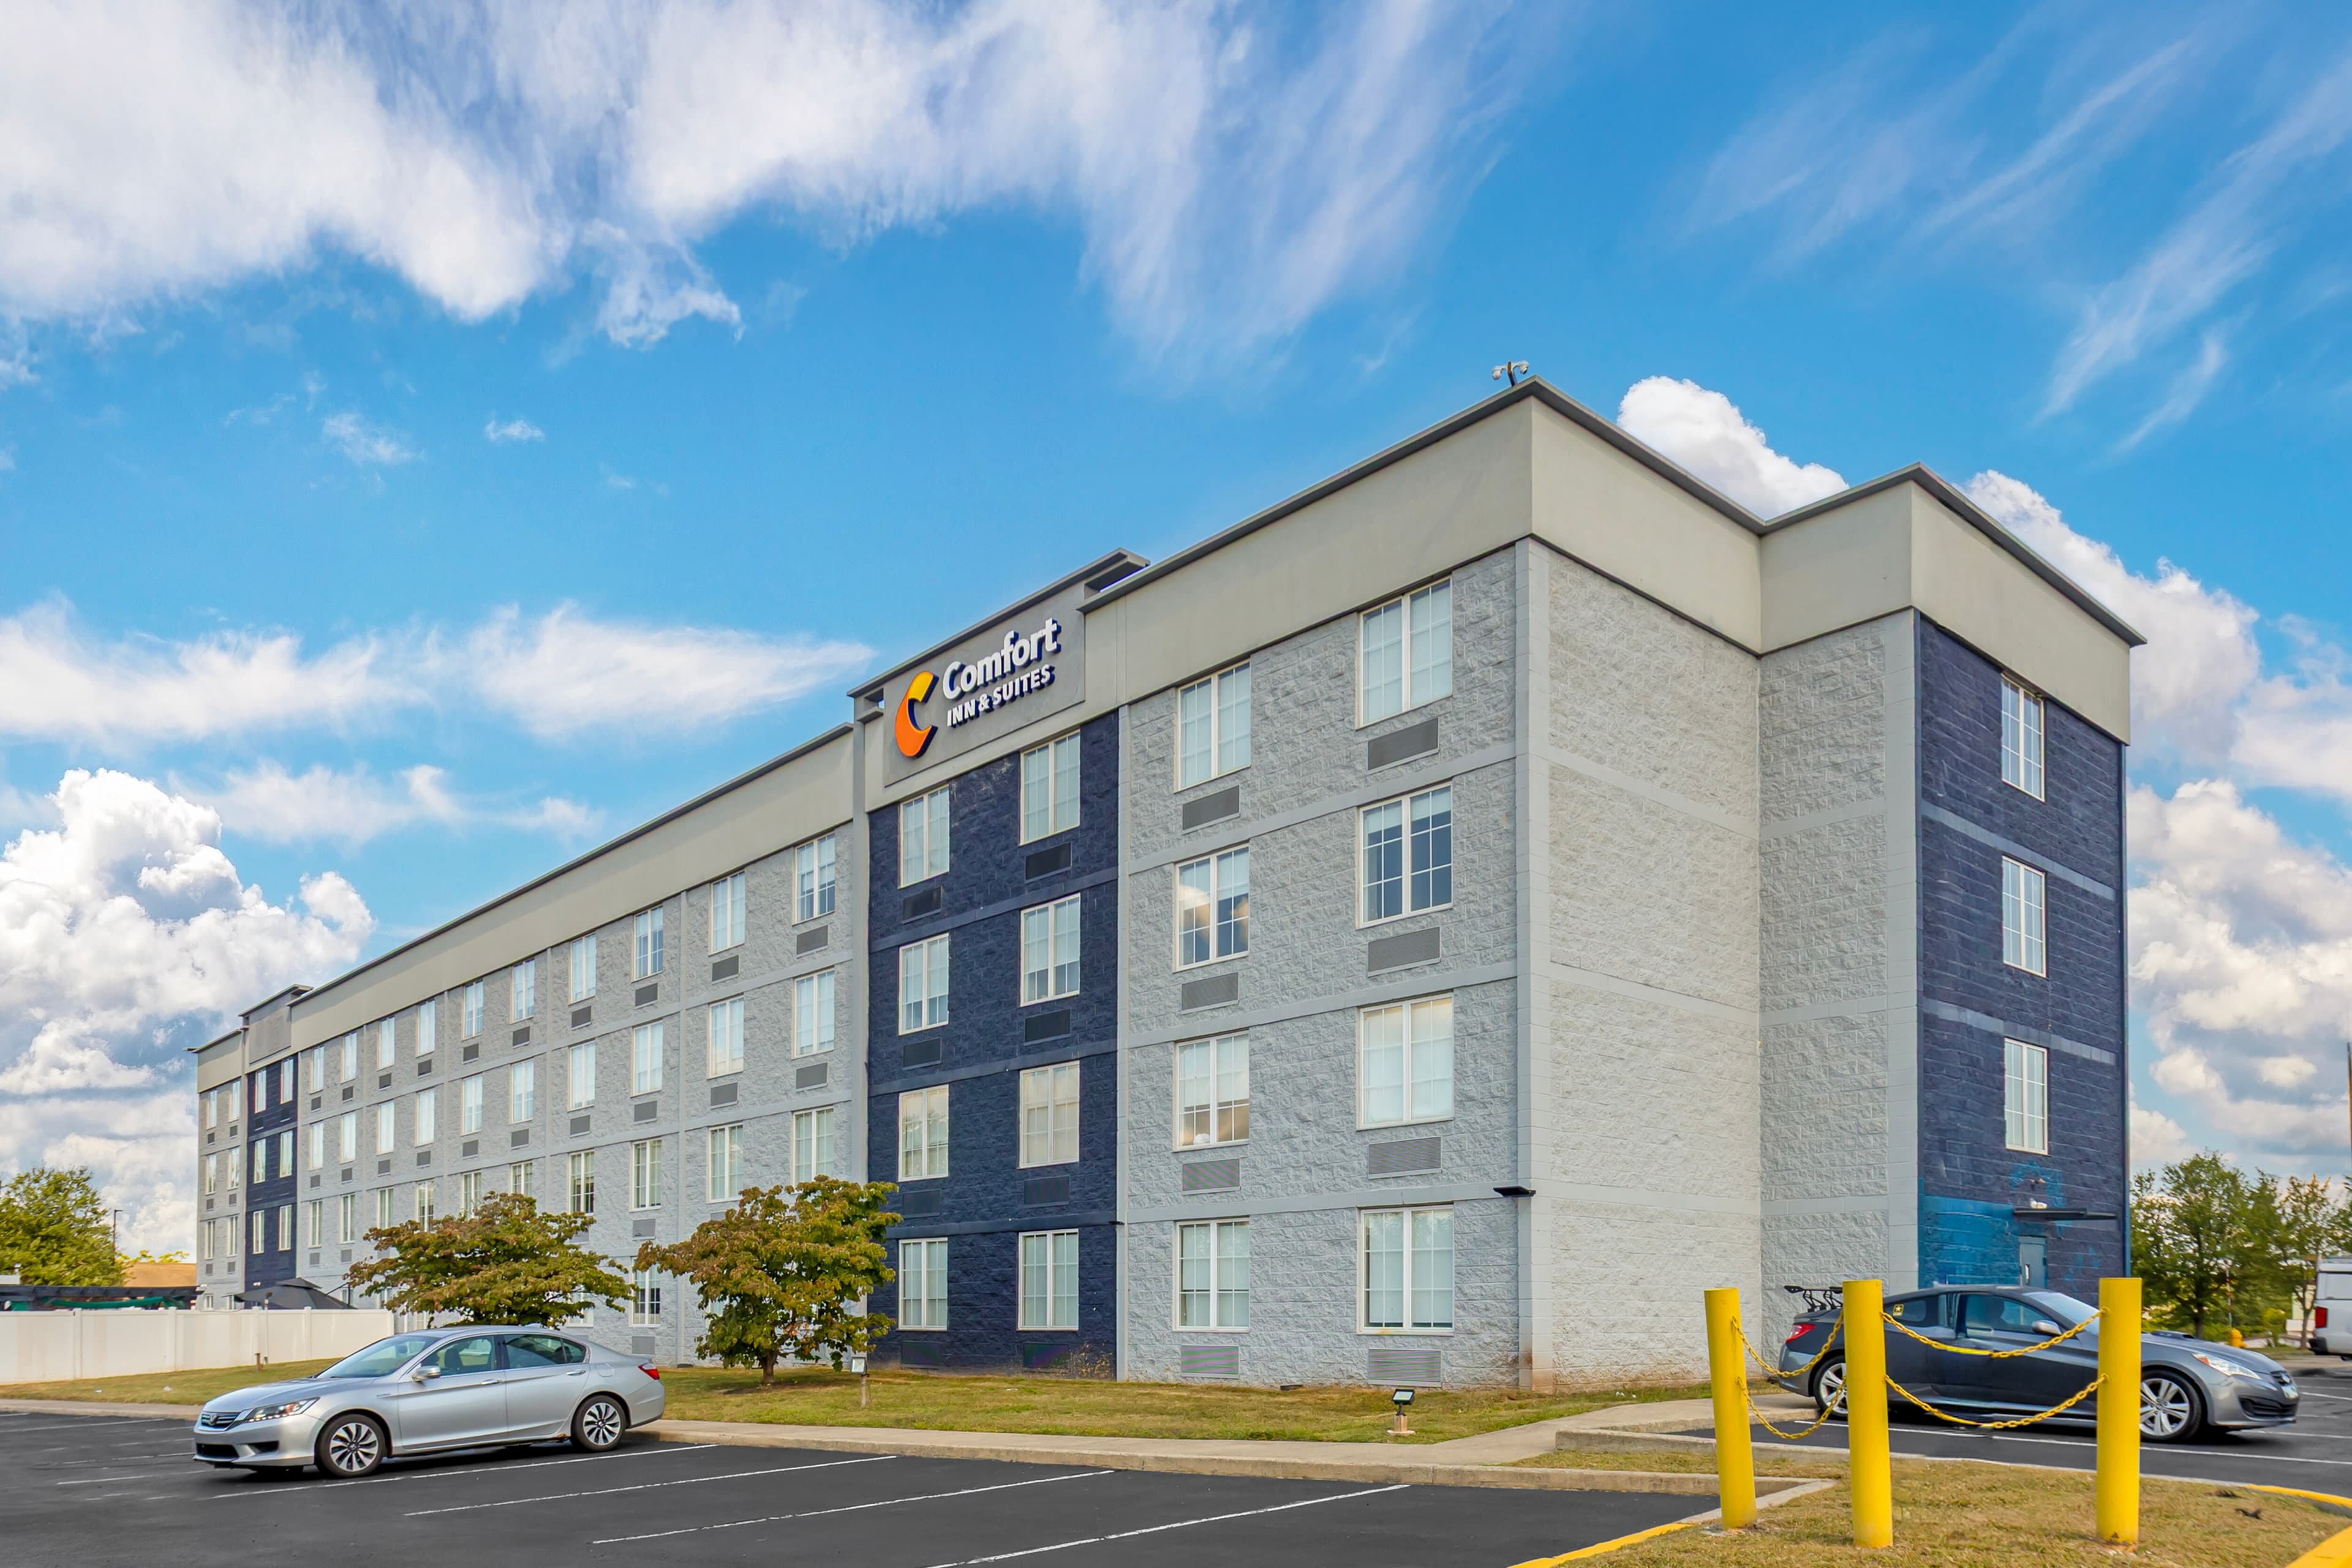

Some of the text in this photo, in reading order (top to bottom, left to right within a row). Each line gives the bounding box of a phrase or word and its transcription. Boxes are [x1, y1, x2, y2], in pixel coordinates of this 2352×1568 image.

[943, 617, 1061, 701] Comfort
[947, 664, 1055, 728] INN & SUITES
